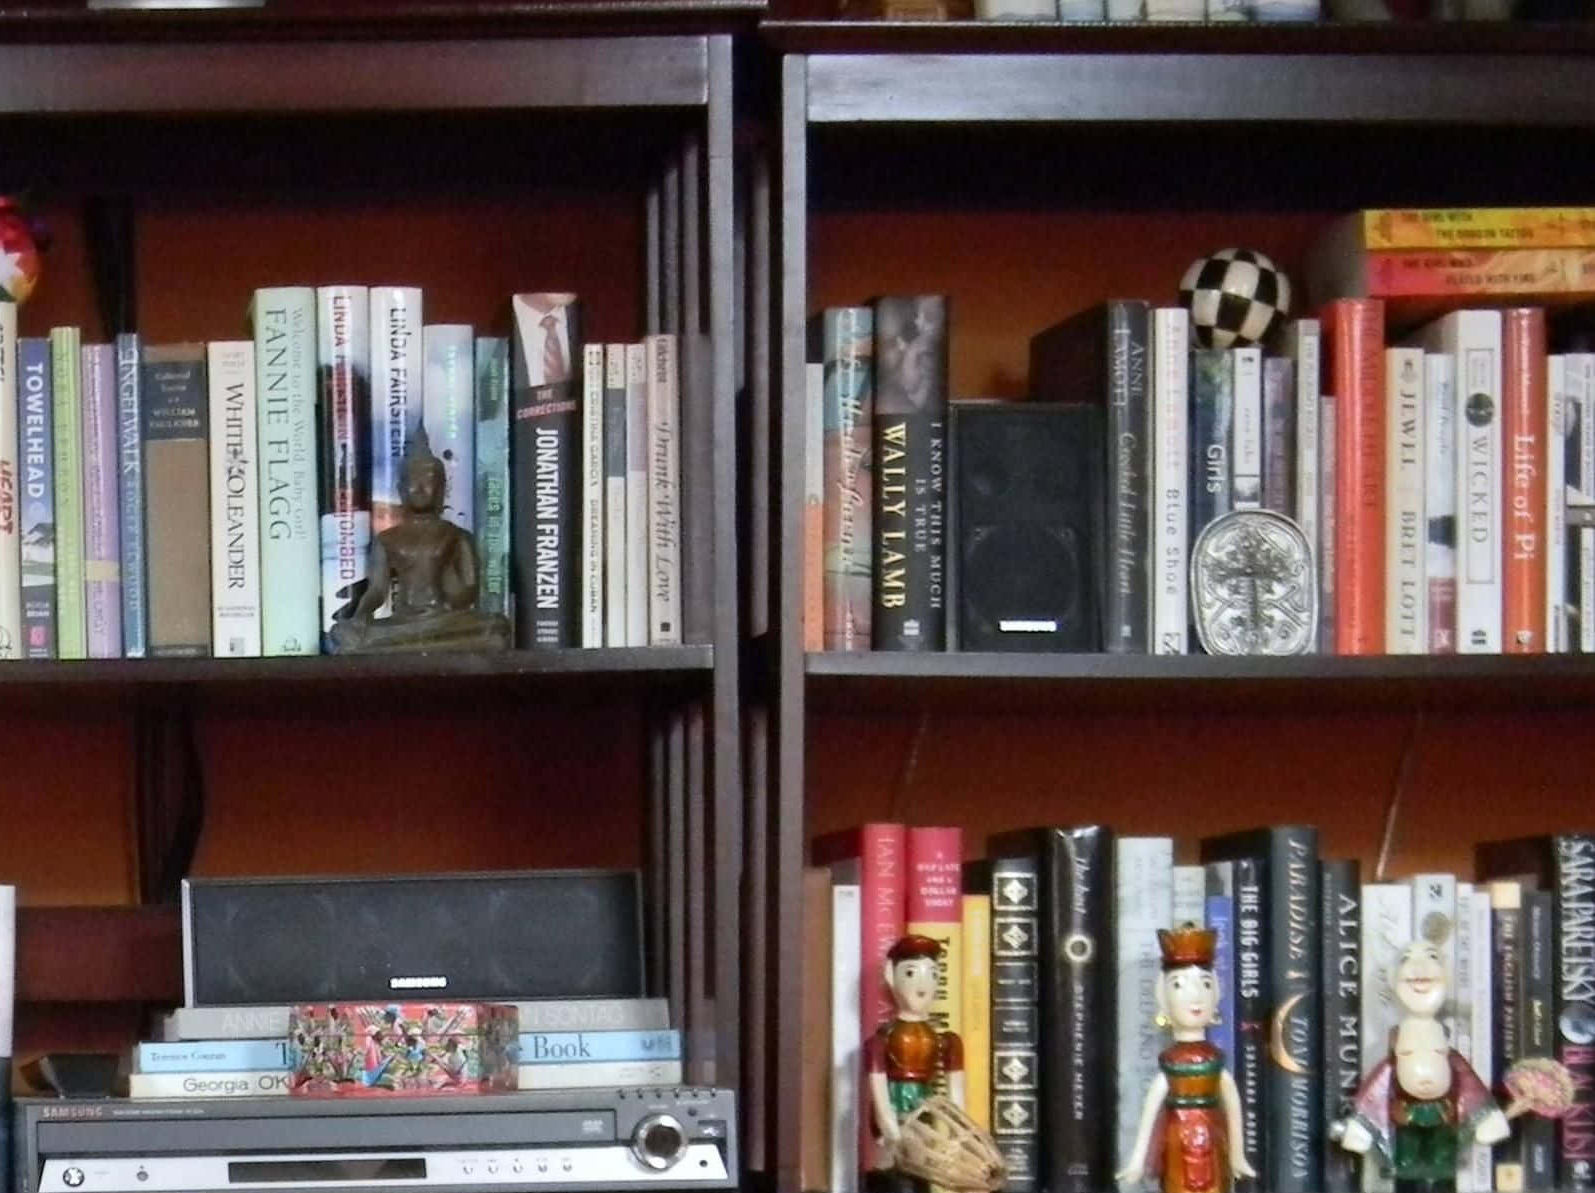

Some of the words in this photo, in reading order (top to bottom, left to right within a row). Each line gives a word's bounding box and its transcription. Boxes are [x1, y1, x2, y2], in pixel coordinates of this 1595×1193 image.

[289, 307, 305, 369] Welcome
[265, 308, 289, 425] FANNIE
[292, 374, 304, 389] to
[25, 362, 45, 499] TOWELHEAD
[224, 383, 246, 451] WHITE
[292, 393, 306, 417] the
[535, 427, 559, 519] JONATHAN
[881, 423, 907, 518] WALLY
[914, 478, 928, 494] IS
[929, 437, 943, 492] KNOW
[1206, 443, 1227, 493] Girls
[1513, 434, 1537, 488] Life
[267, 440, 292, 541] FLAGG
[1164, 488, 1181, 536] Blue
[1471, 435, 1490, 544] WICKED
[1512, 496, 1537, 522] of
[225, 474, 247, 590] OLEANDER
[914, 504, 928, 553] TRUE
[929, 503, 943, 546] THIS
[1513, 534, 1536, 560] Pi
[536, 523, 560, 609] FRANZEN
[882, 531, 907, 609] LAMB
[929, 555, 943, 609] MUCH
[1165, 546, 1181, 596] Shoe
[1240, 885, 1259, 916] THE
[1287, 839, 1307, 960] PARADISE
[1240, 918, 1259, 948] BIG
[1338, 893, 1360, 998] ALICE
[1240, 952, 1260, 999] GIRLS
[533, 1033, 592, 1060] Book
[42, 1105, 103, 1117] SAMSUNG
[183, 1077, 249, 1094] Georgia
[1288, 1077, 1309, 1178] MORRISON
